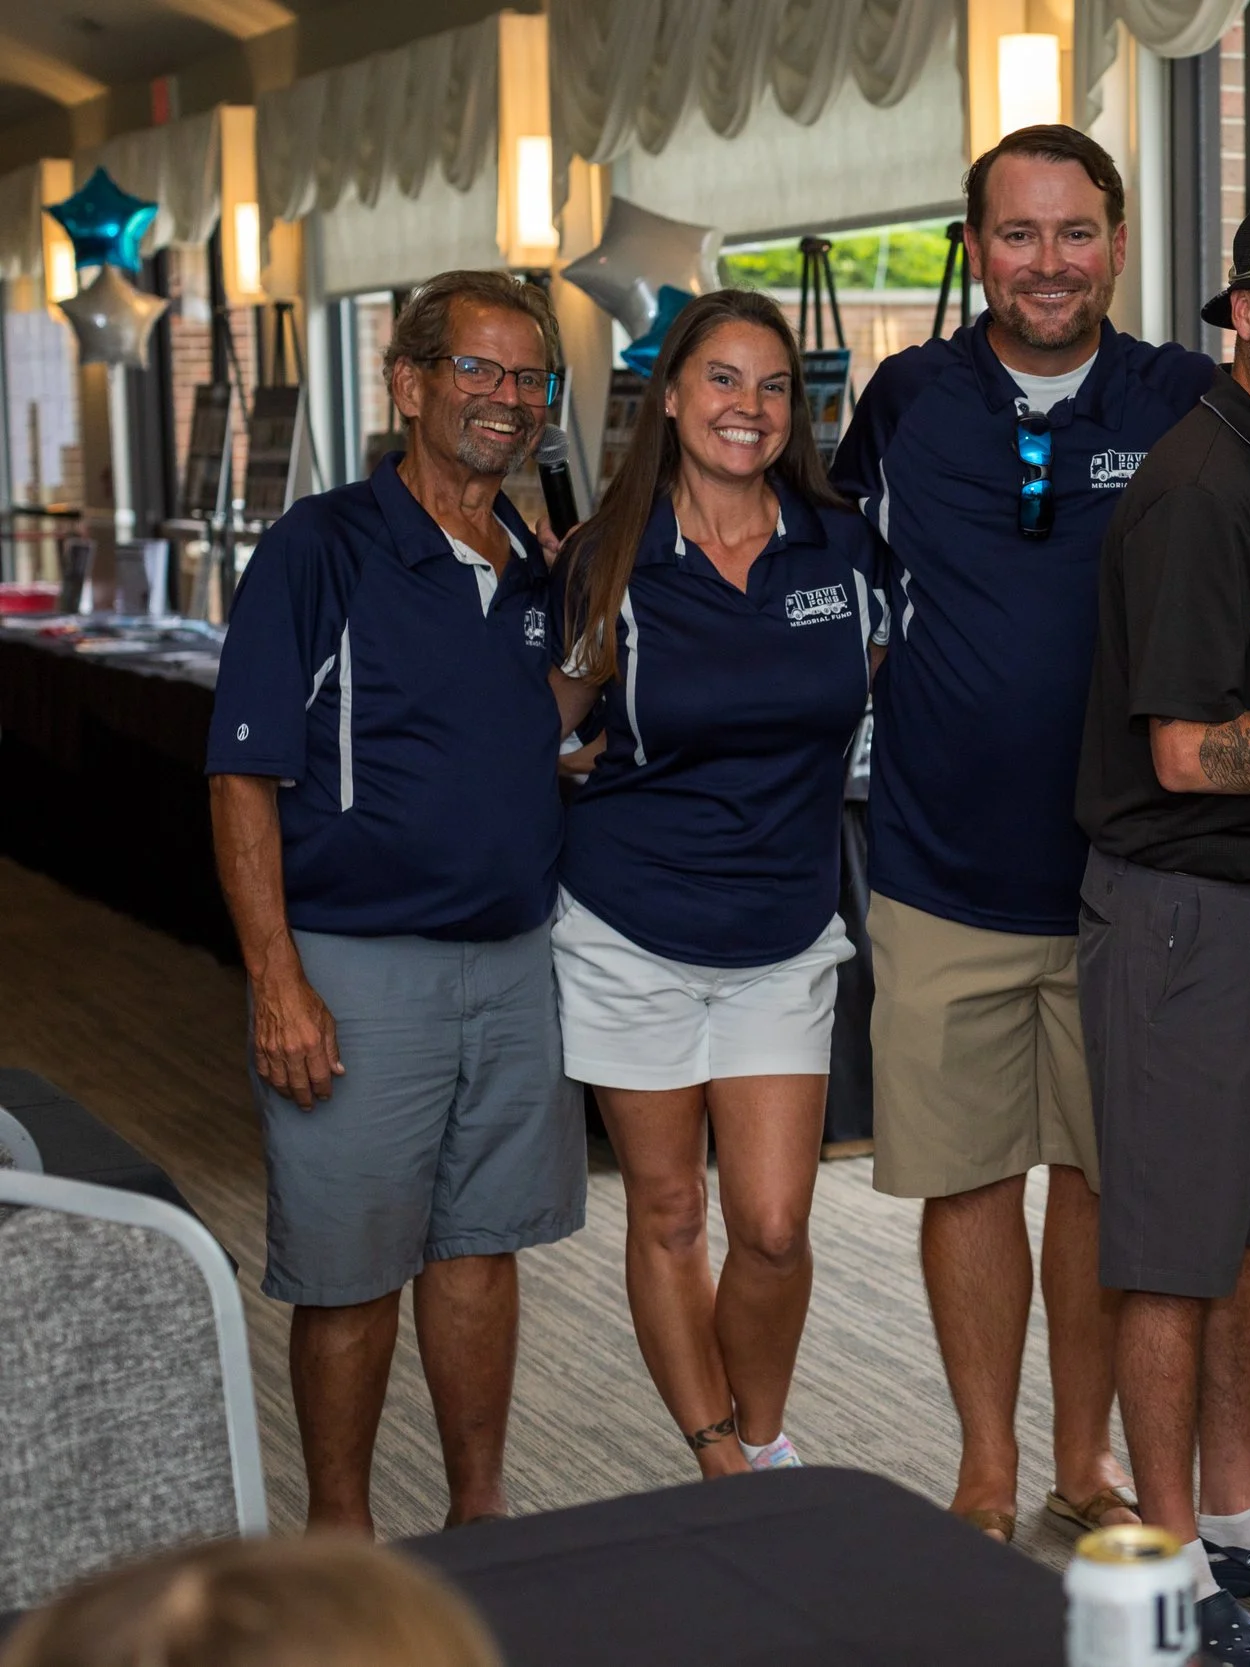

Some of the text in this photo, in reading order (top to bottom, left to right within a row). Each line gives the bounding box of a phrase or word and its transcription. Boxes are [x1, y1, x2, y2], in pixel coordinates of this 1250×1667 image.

[1118, 454, 1147, 462] DAV
[806, 588, 838, 600] DAVE
[808, 595, 840, 608] FONS
[790, 611, 853, 628] MEMORIAL FUND
